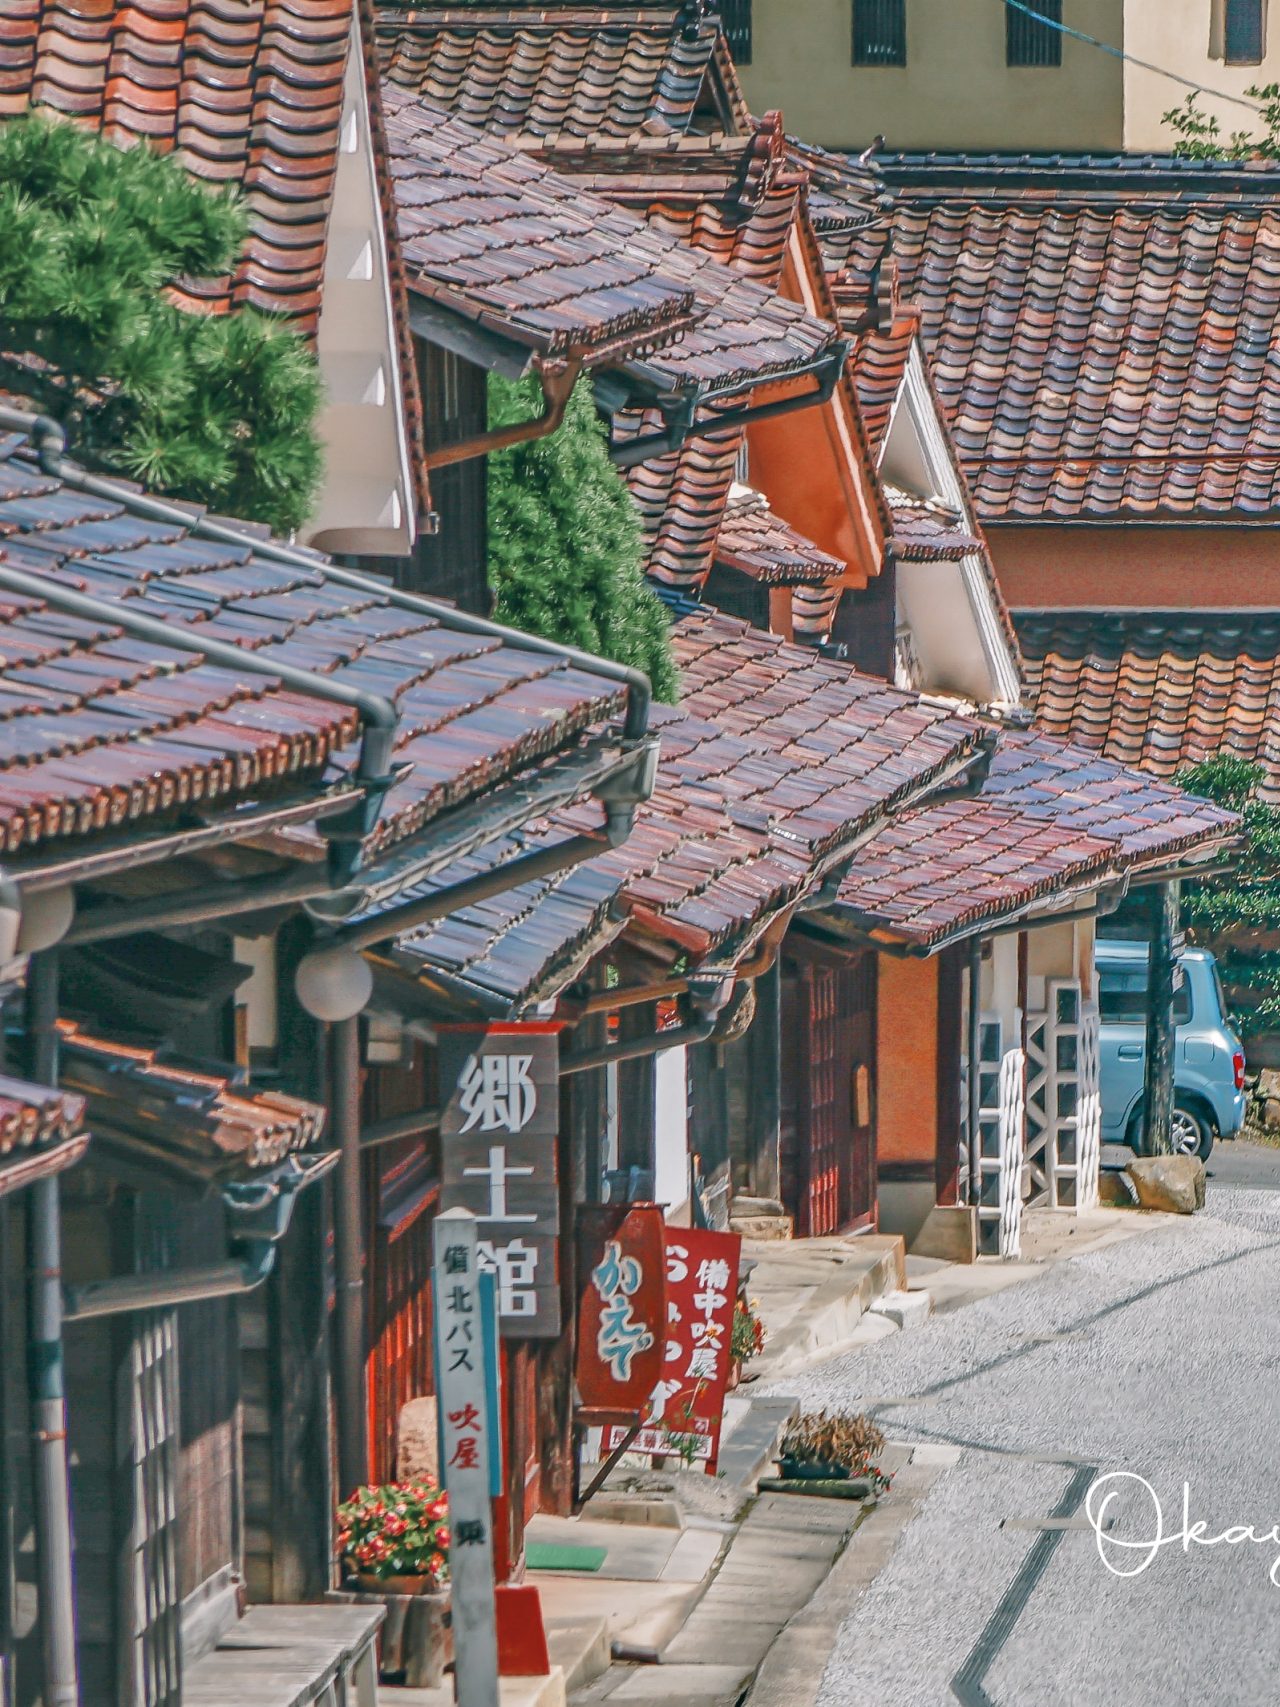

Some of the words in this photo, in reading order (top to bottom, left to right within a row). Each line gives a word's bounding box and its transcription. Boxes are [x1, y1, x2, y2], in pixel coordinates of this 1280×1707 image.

[457, 1053, 540, 1318] 郷土館
[443, 1244, 474, 1373] 備北バス
[592, 1240, 655, 1382] かえで
[684, 1258, 731, 1381] 備中吹屋
[446, 1402, 483, 1470] 吹屋
